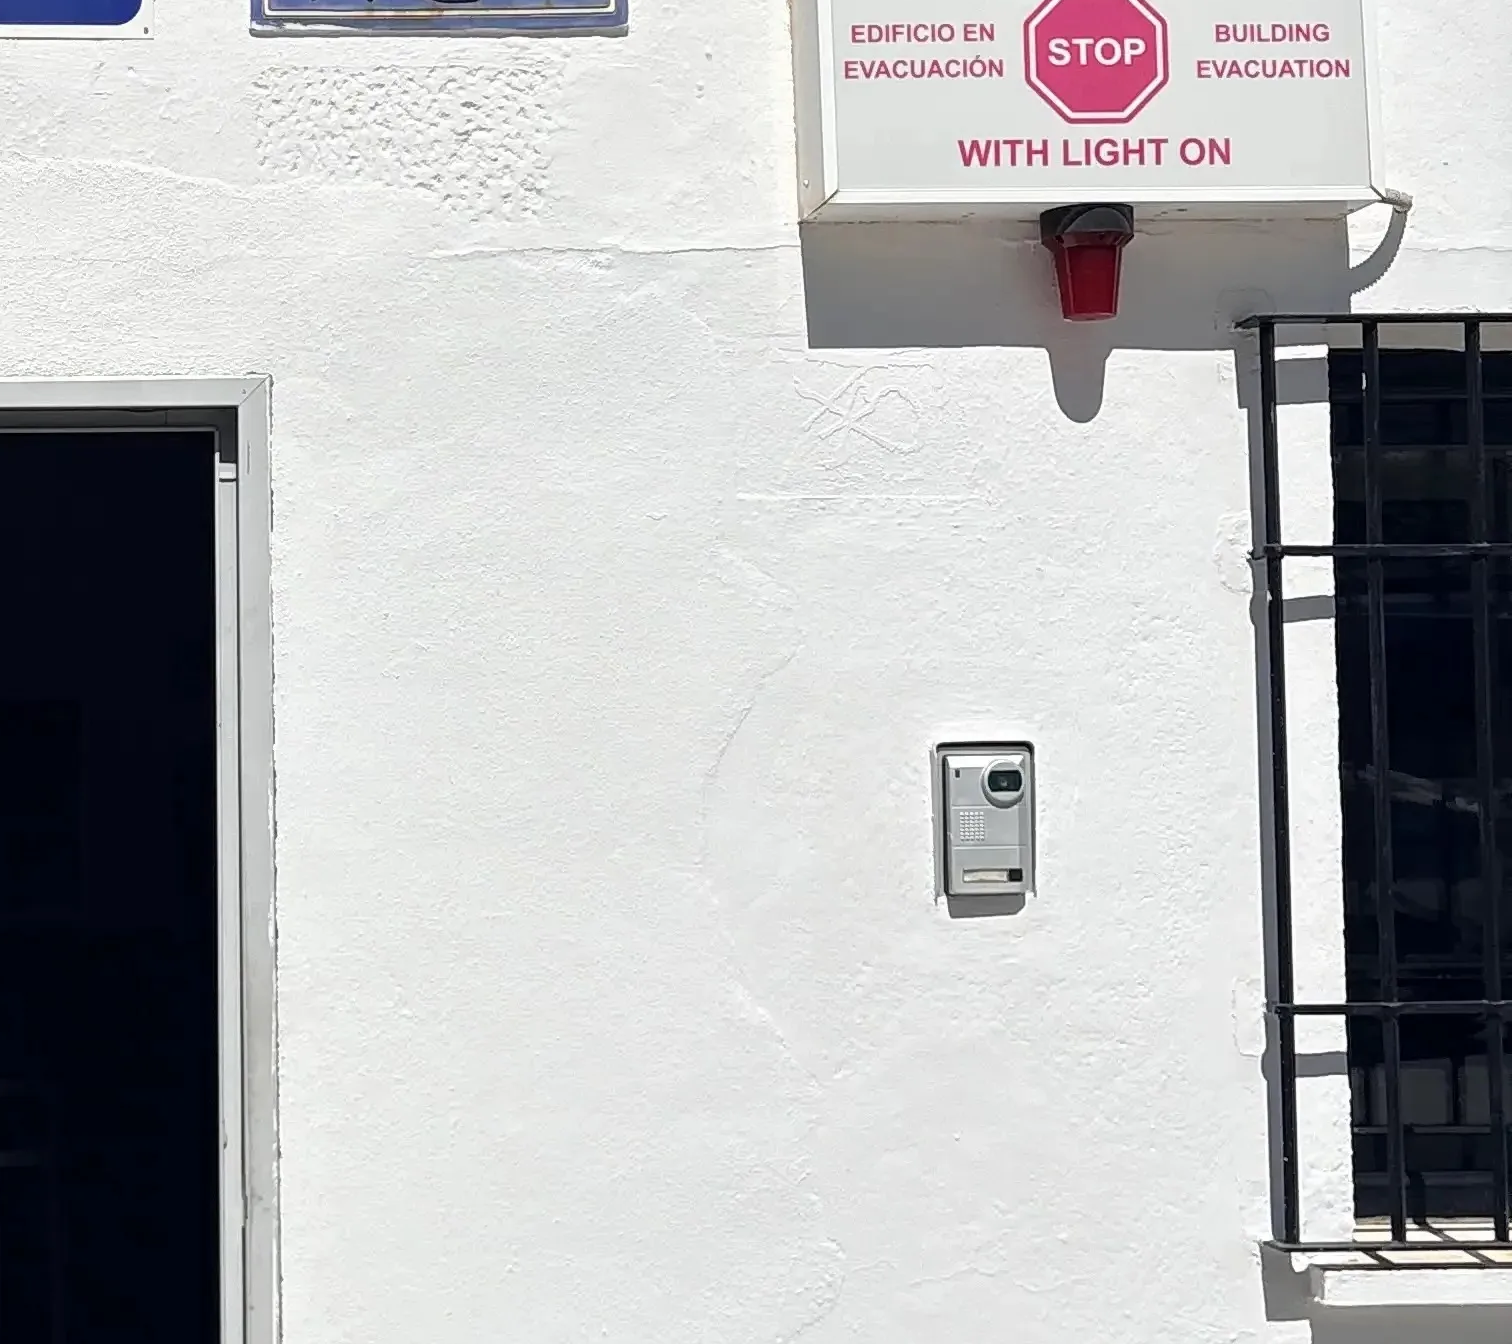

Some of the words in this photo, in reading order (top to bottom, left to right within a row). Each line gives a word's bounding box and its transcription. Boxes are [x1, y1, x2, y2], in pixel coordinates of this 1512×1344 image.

[850, 23, 955, 44] EDIFICIO
[963, 23, 996, 43] EN
[1214, 23, 1330, 43] BUILDING
[1046, 37, 1147, 67] STOP
[843, 55, 1005, 80] EVACUACIÓN
[1196, 59, 1351, 79] EVACUATION
[958, 139, 1050, 168] WITH
[1062, 138, 1168, 167] LIGHT
[1179, 137, 1232, 166] ON
